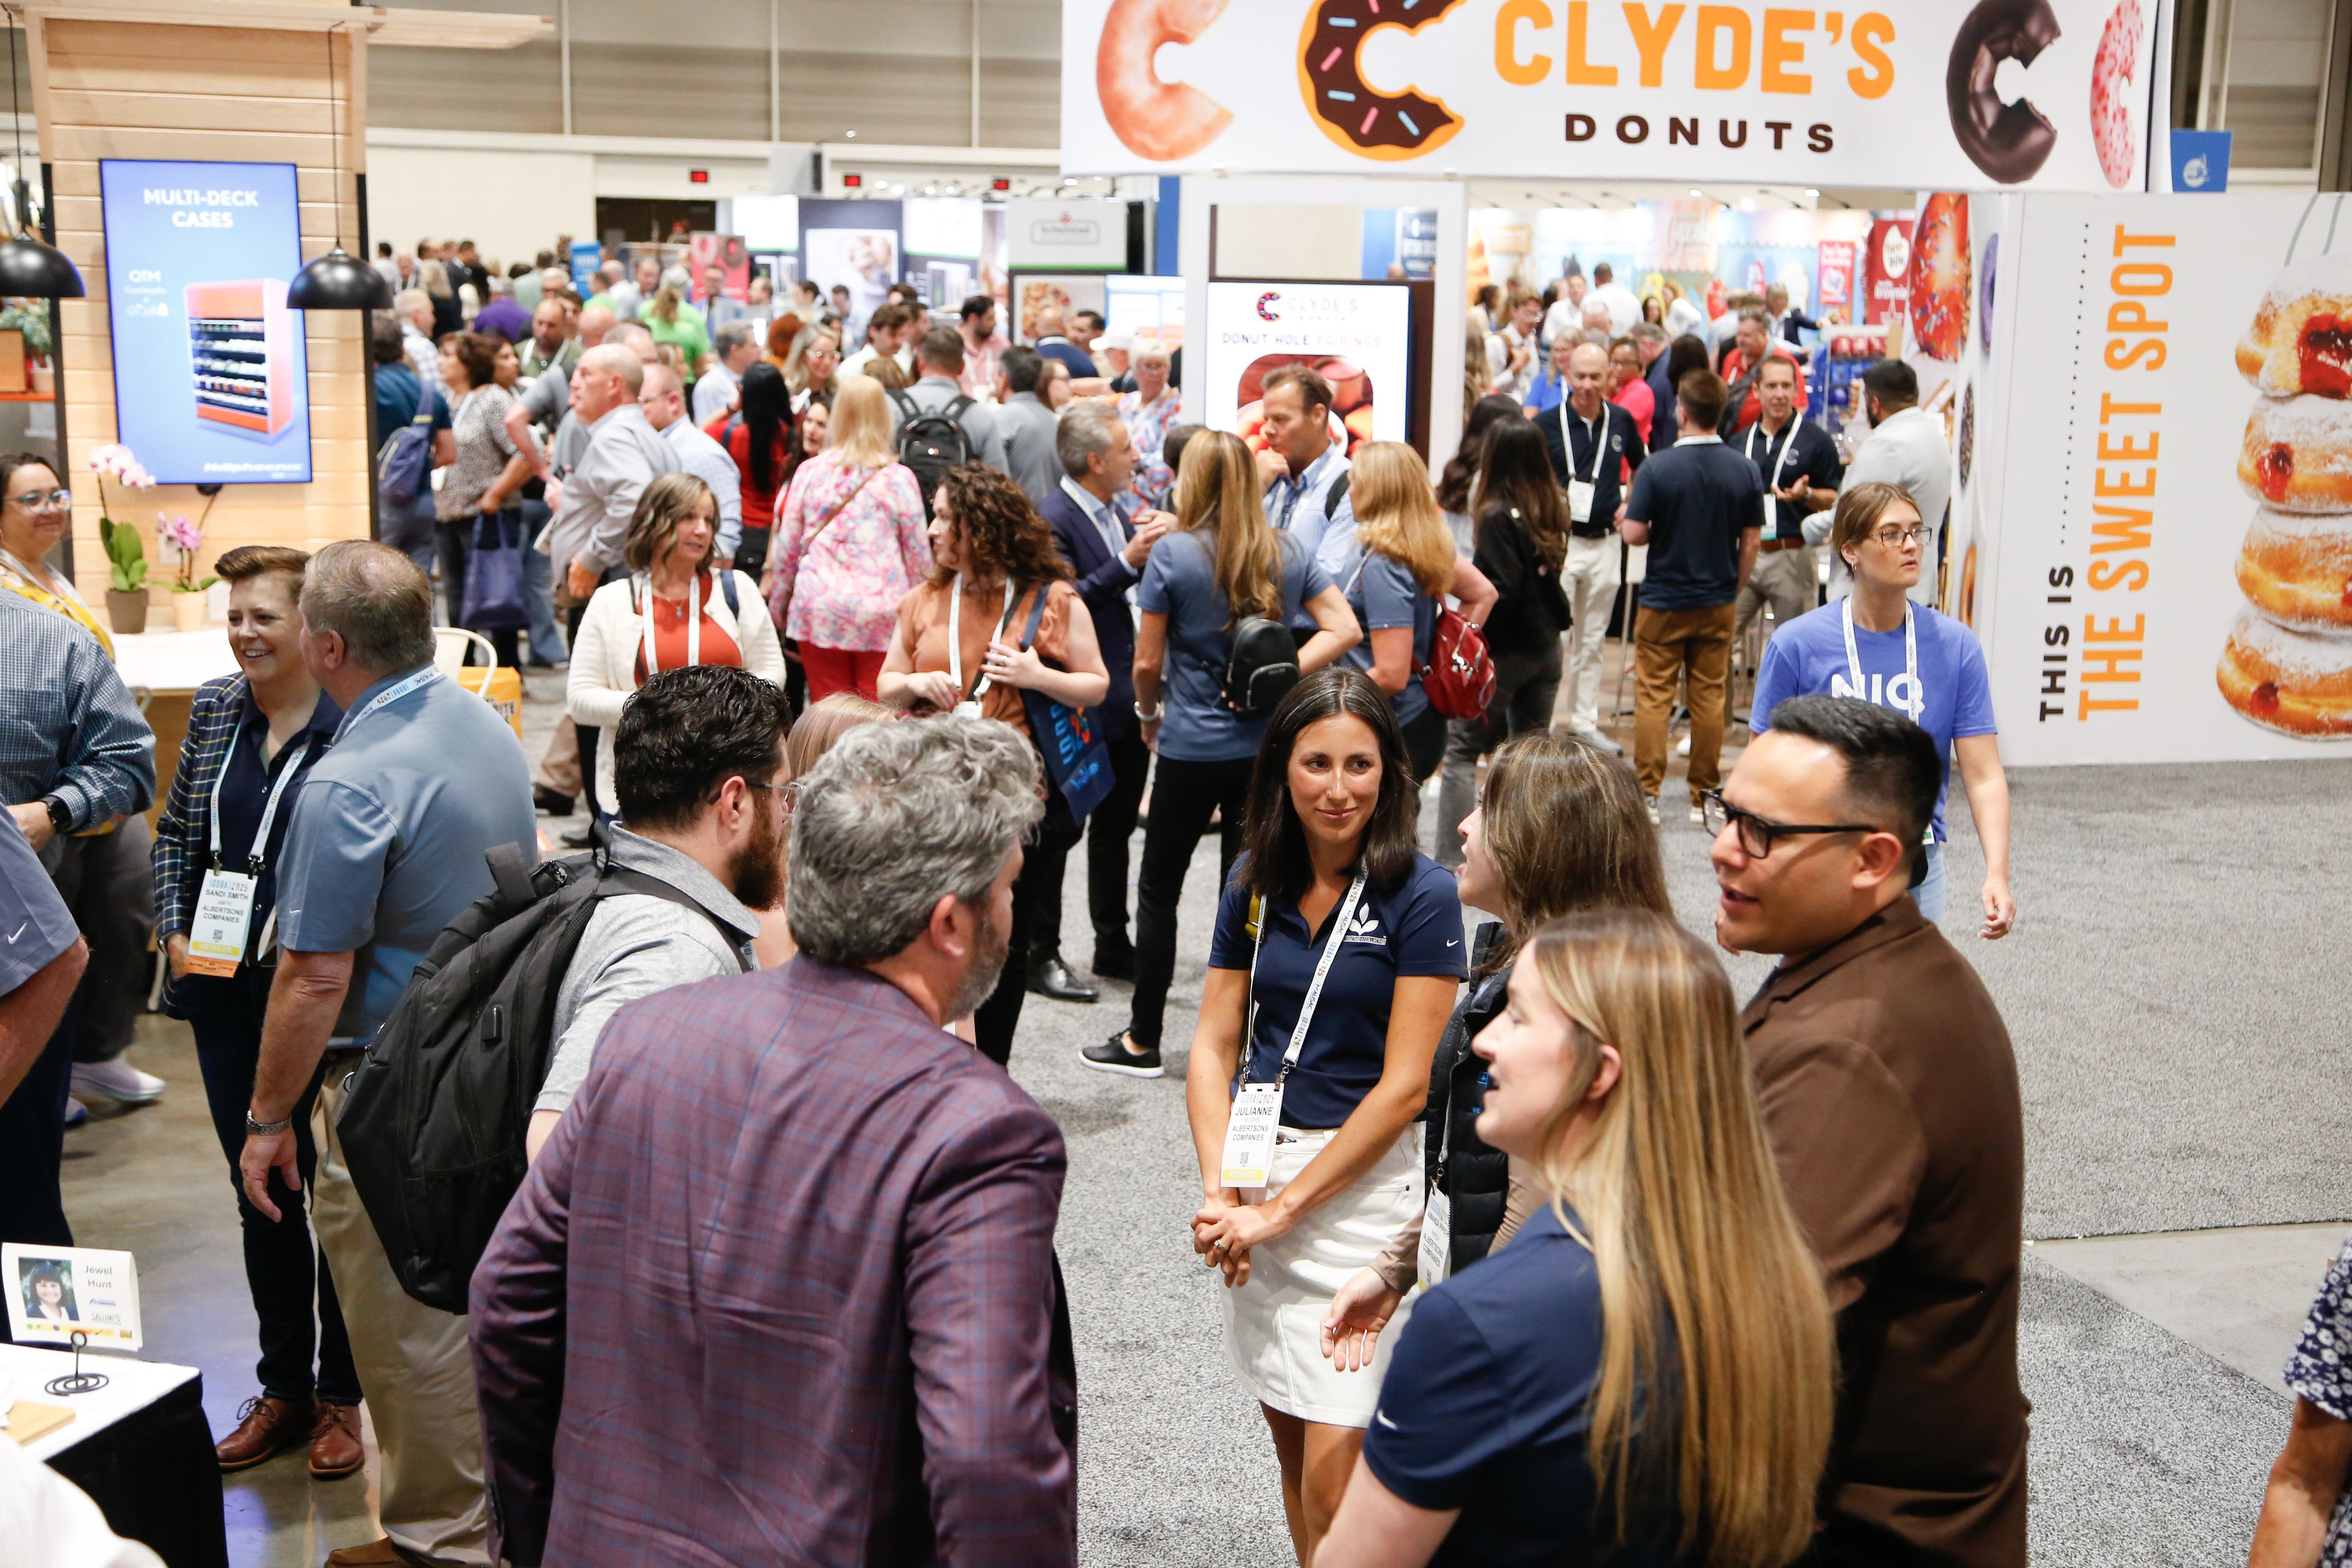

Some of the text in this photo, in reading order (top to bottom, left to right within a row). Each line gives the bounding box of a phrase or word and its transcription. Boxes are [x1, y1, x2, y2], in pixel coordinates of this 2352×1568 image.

[1494, 0, 1896, 99] CLYDE'S
[1565, 113, 1834, 153] DONUTS
[143, 187, 259, 207] MULTI-DECK
[172, 211, 234, 228] CASES
[1288, 297, 1359, 312] CLYDES
[1222, 333, 1268, 344] DONUT
[1275, 335, 1309, 345] HOLE
[2078, 224, 2177, 722] THE SWEET SPOT
[2040, 565, 2075, 722] THIS IS
[228, 892, 249, 901] SMITH
[203, 905, 244, 916] ALBERTSONS
[203, 913, 239, 924] COMPANIES
[1337, 910, 1352, 936] MAUSAC
[1306, 984, 1321, 1011] MAUSAC
[1235, 1107, 1274, 1116] JULIANNE
[1423, 1232, 1444, 1259] ALBERTSONS
[1422, 1243, 1441, 1267] COMPANIES
[85, 1264, 113, 1275] Jewel
[88, 1278, 112, 1289] Hunt
